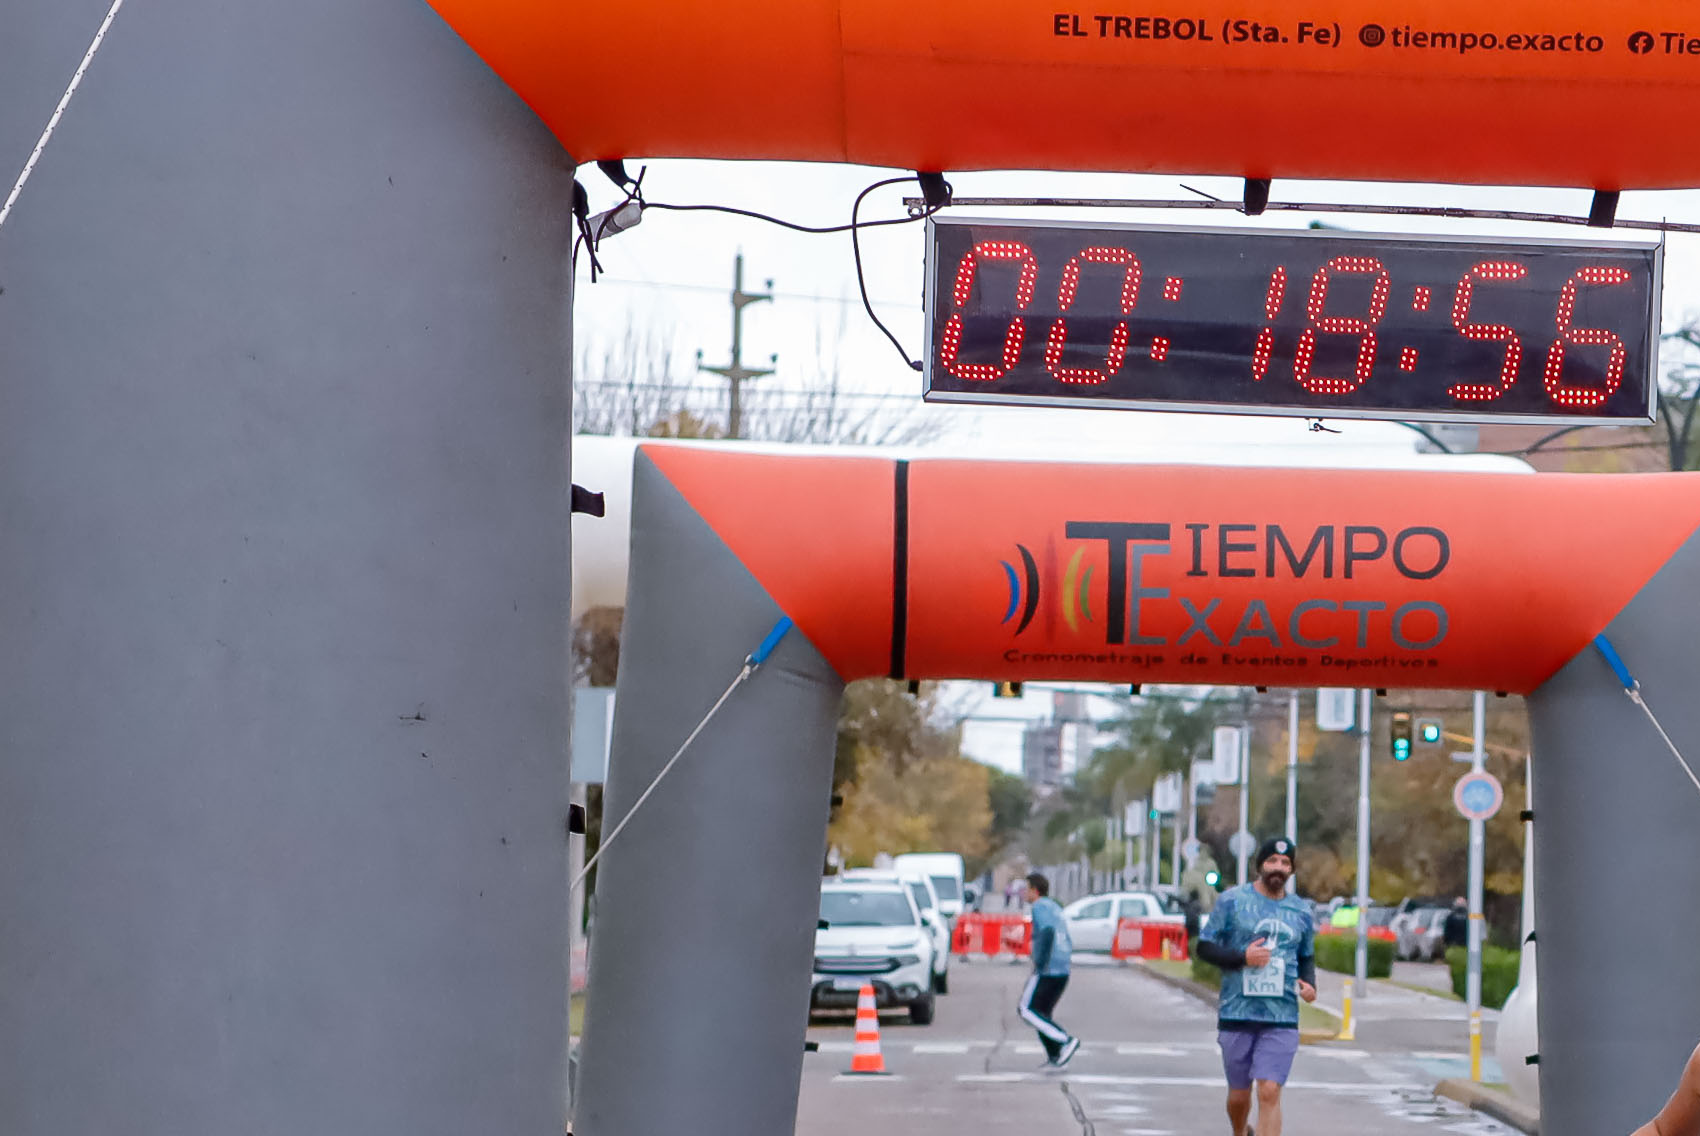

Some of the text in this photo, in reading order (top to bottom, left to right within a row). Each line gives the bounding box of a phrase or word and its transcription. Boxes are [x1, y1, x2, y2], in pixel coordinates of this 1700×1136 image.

[1053, 14, 1341, 47] EL TREBOL (Sta. Fe)
[1391, 25, 1604, 54] tiempo.exacto
[1065, 521, 1450, 645] TIEMPO
[1129, 543, 1449, 650] EXACTO
[1003, 649, 1439, 670] Cronometraje de Eventos Deportivos
